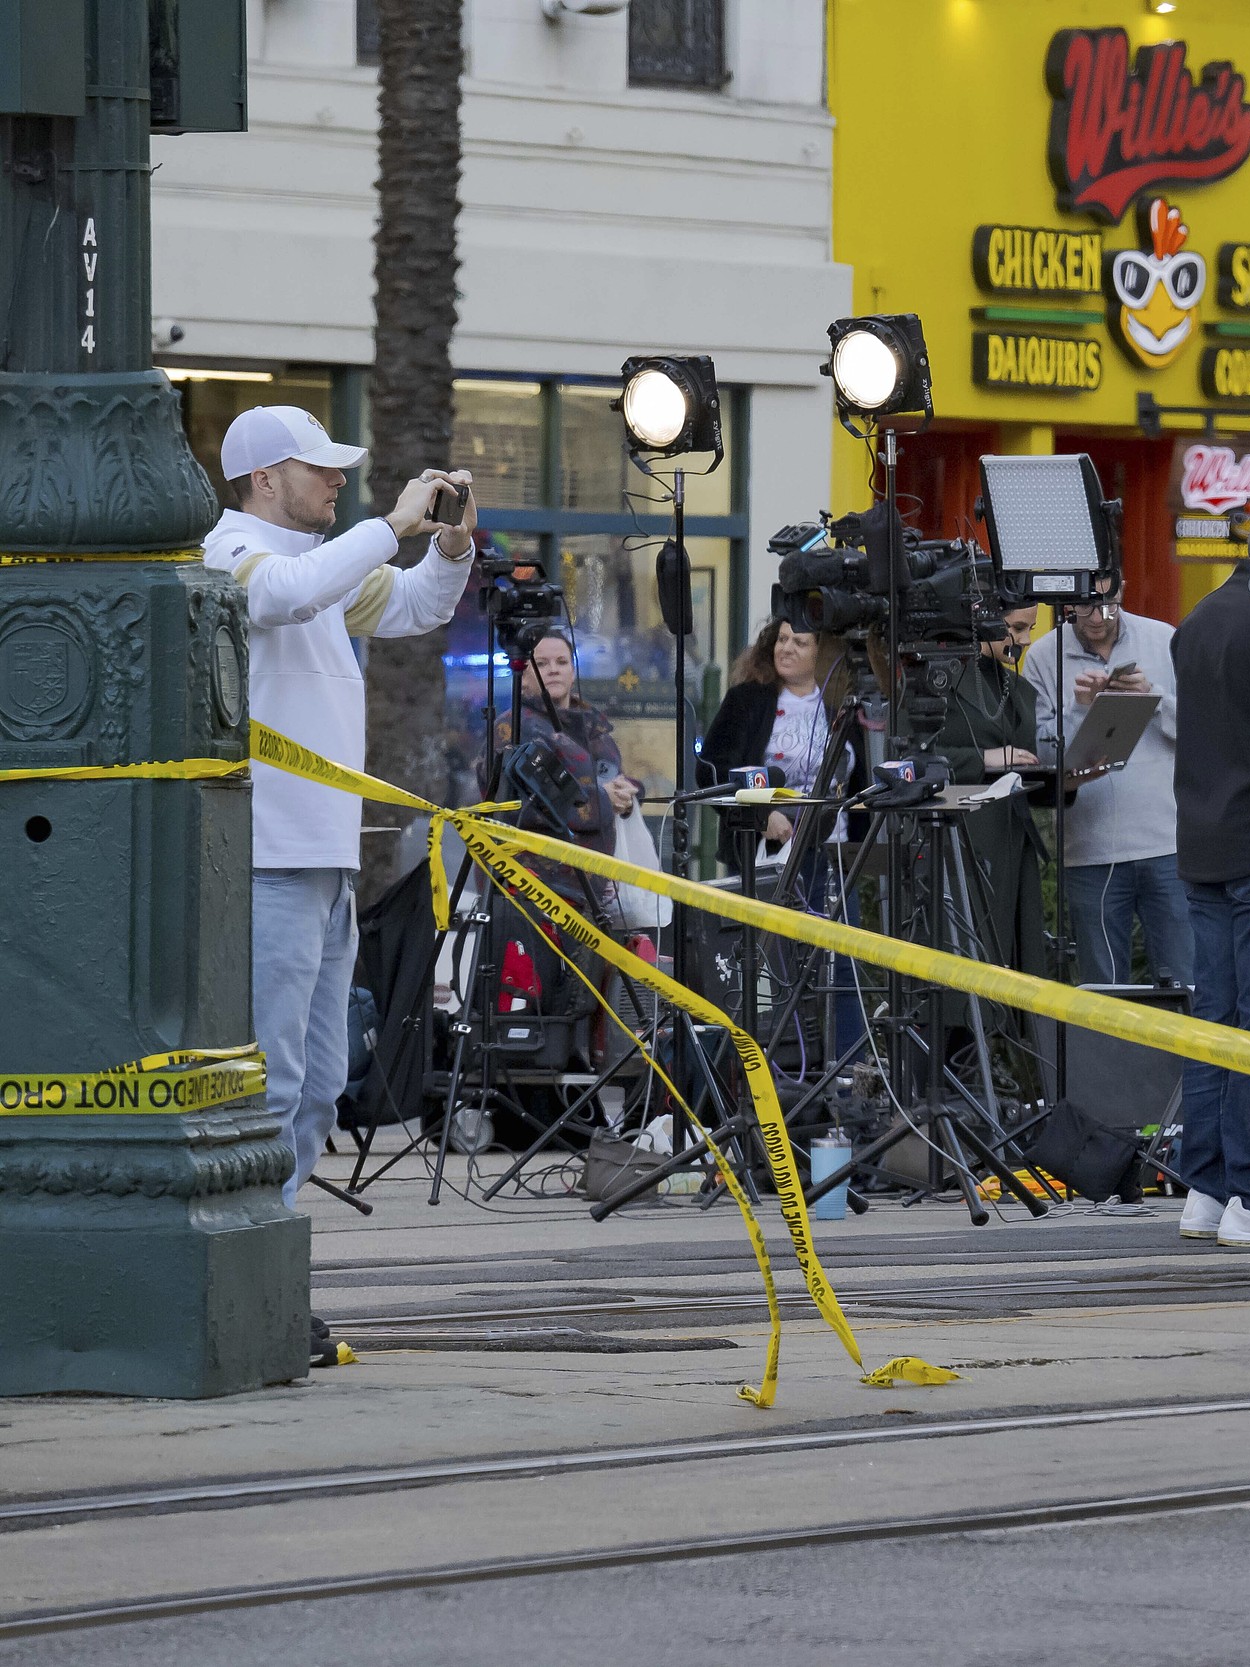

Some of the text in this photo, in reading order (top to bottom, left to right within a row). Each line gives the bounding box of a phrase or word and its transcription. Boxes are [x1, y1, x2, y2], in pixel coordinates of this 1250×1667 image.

[987, 228, 1100, 291] CHICKEN
[987, 334, 1100, 389] DAIQUIRIS
[922, 378, 932, 409] zylight
[74, 1080, 140, 1109] NOT
[149, 1078, 187, 1108] DO
[211, 1070, 245, 1100] POLICE
[761, 1122, 786, 1162] CROSS
[773, 1165, 793, 1189] NOT
